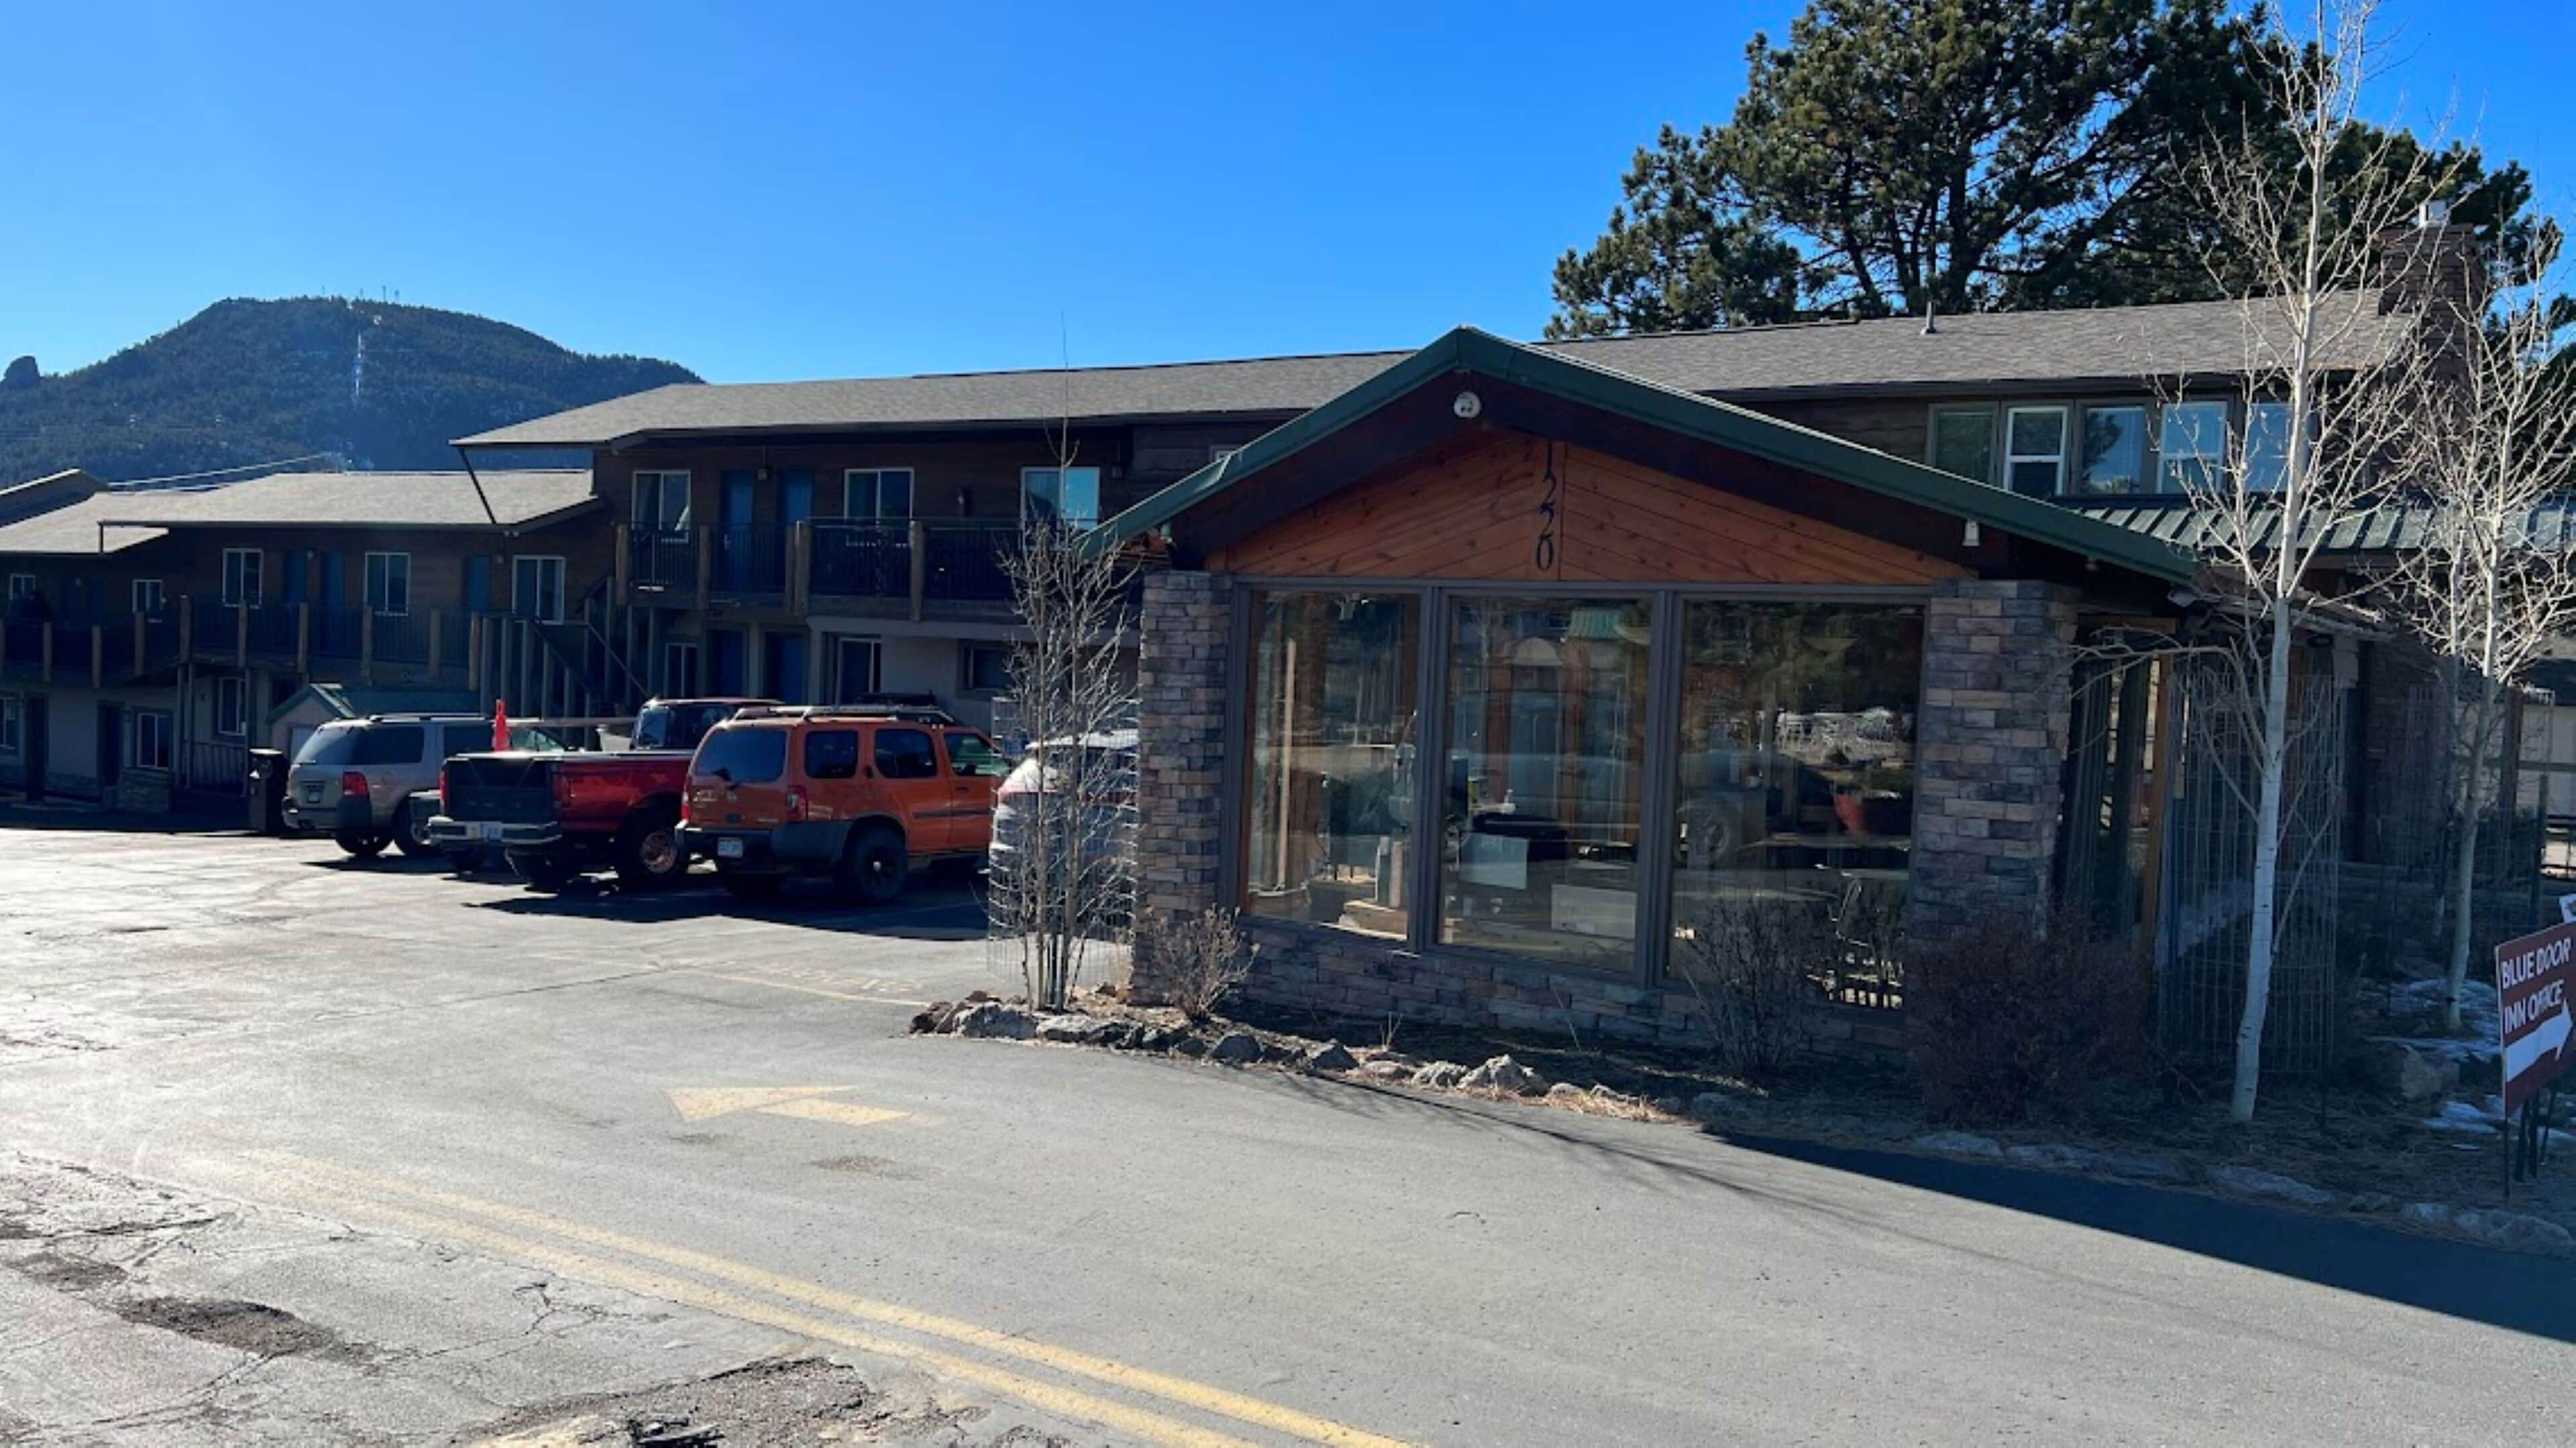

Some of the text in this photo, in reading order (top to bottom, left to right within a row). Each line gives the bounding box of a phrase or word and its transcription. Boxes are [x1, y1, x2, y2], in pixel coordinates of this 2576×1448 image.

[2501, 938, 2571, 989] BLUE DOOR
[2505, 979, 2565, 1035] INN OFFICE
